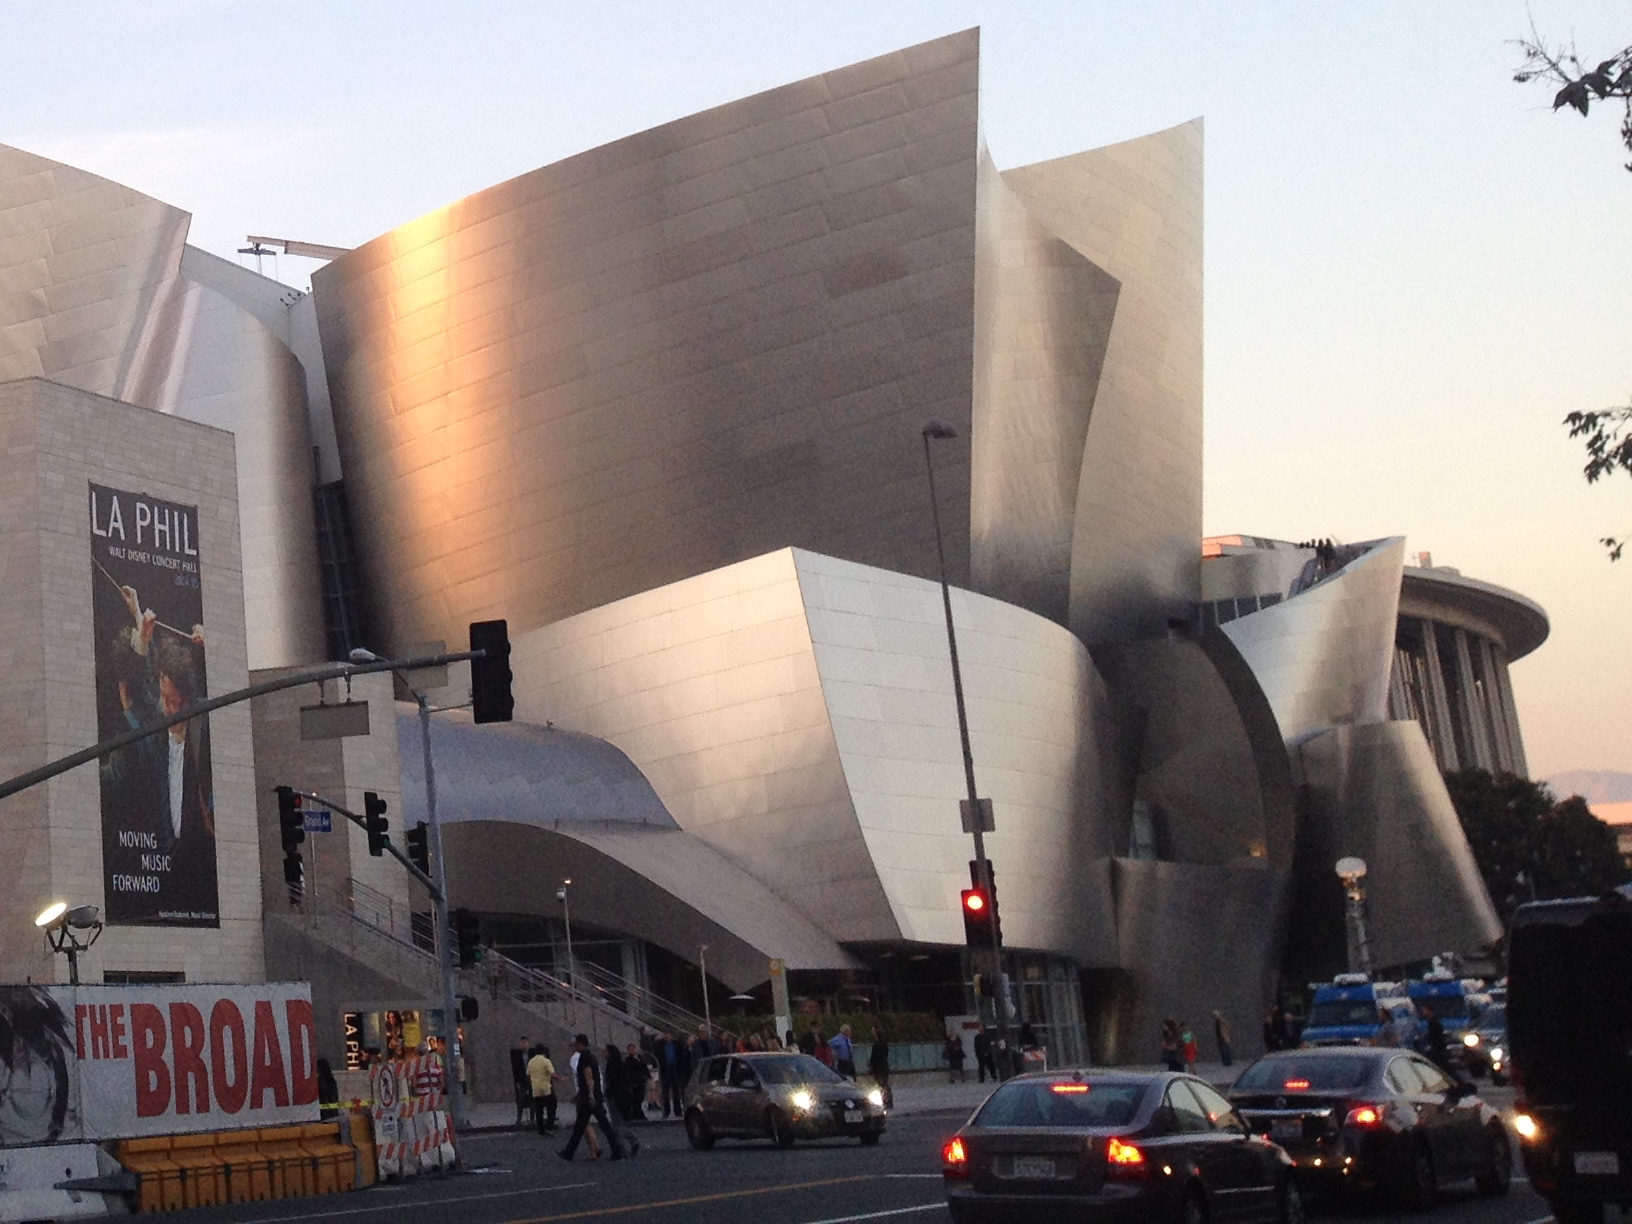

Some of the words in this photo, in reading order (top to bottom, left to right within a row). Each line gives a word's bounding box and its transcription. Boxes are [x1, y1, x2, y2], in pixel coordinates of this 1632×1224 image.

[91, 491, 126, 541] LA
[135, 502, 197, 556] PHIL
[108, 545, 126, 559] WALT
[127, 549, 151, 564] DISNEY
[152, 553, 181, 570] CONCERT
[181, 561, 197, 573] HALL
[118, 830, 158, 849] MOVING
[141, 853, 172, 872] MUSIC
[112, 874, 160, 893] FORWARD
[344, 1013, 358, 1036] LA
[75, 1003, 128, 1060] THE
[130, 998, 318, 1118] BROAD
